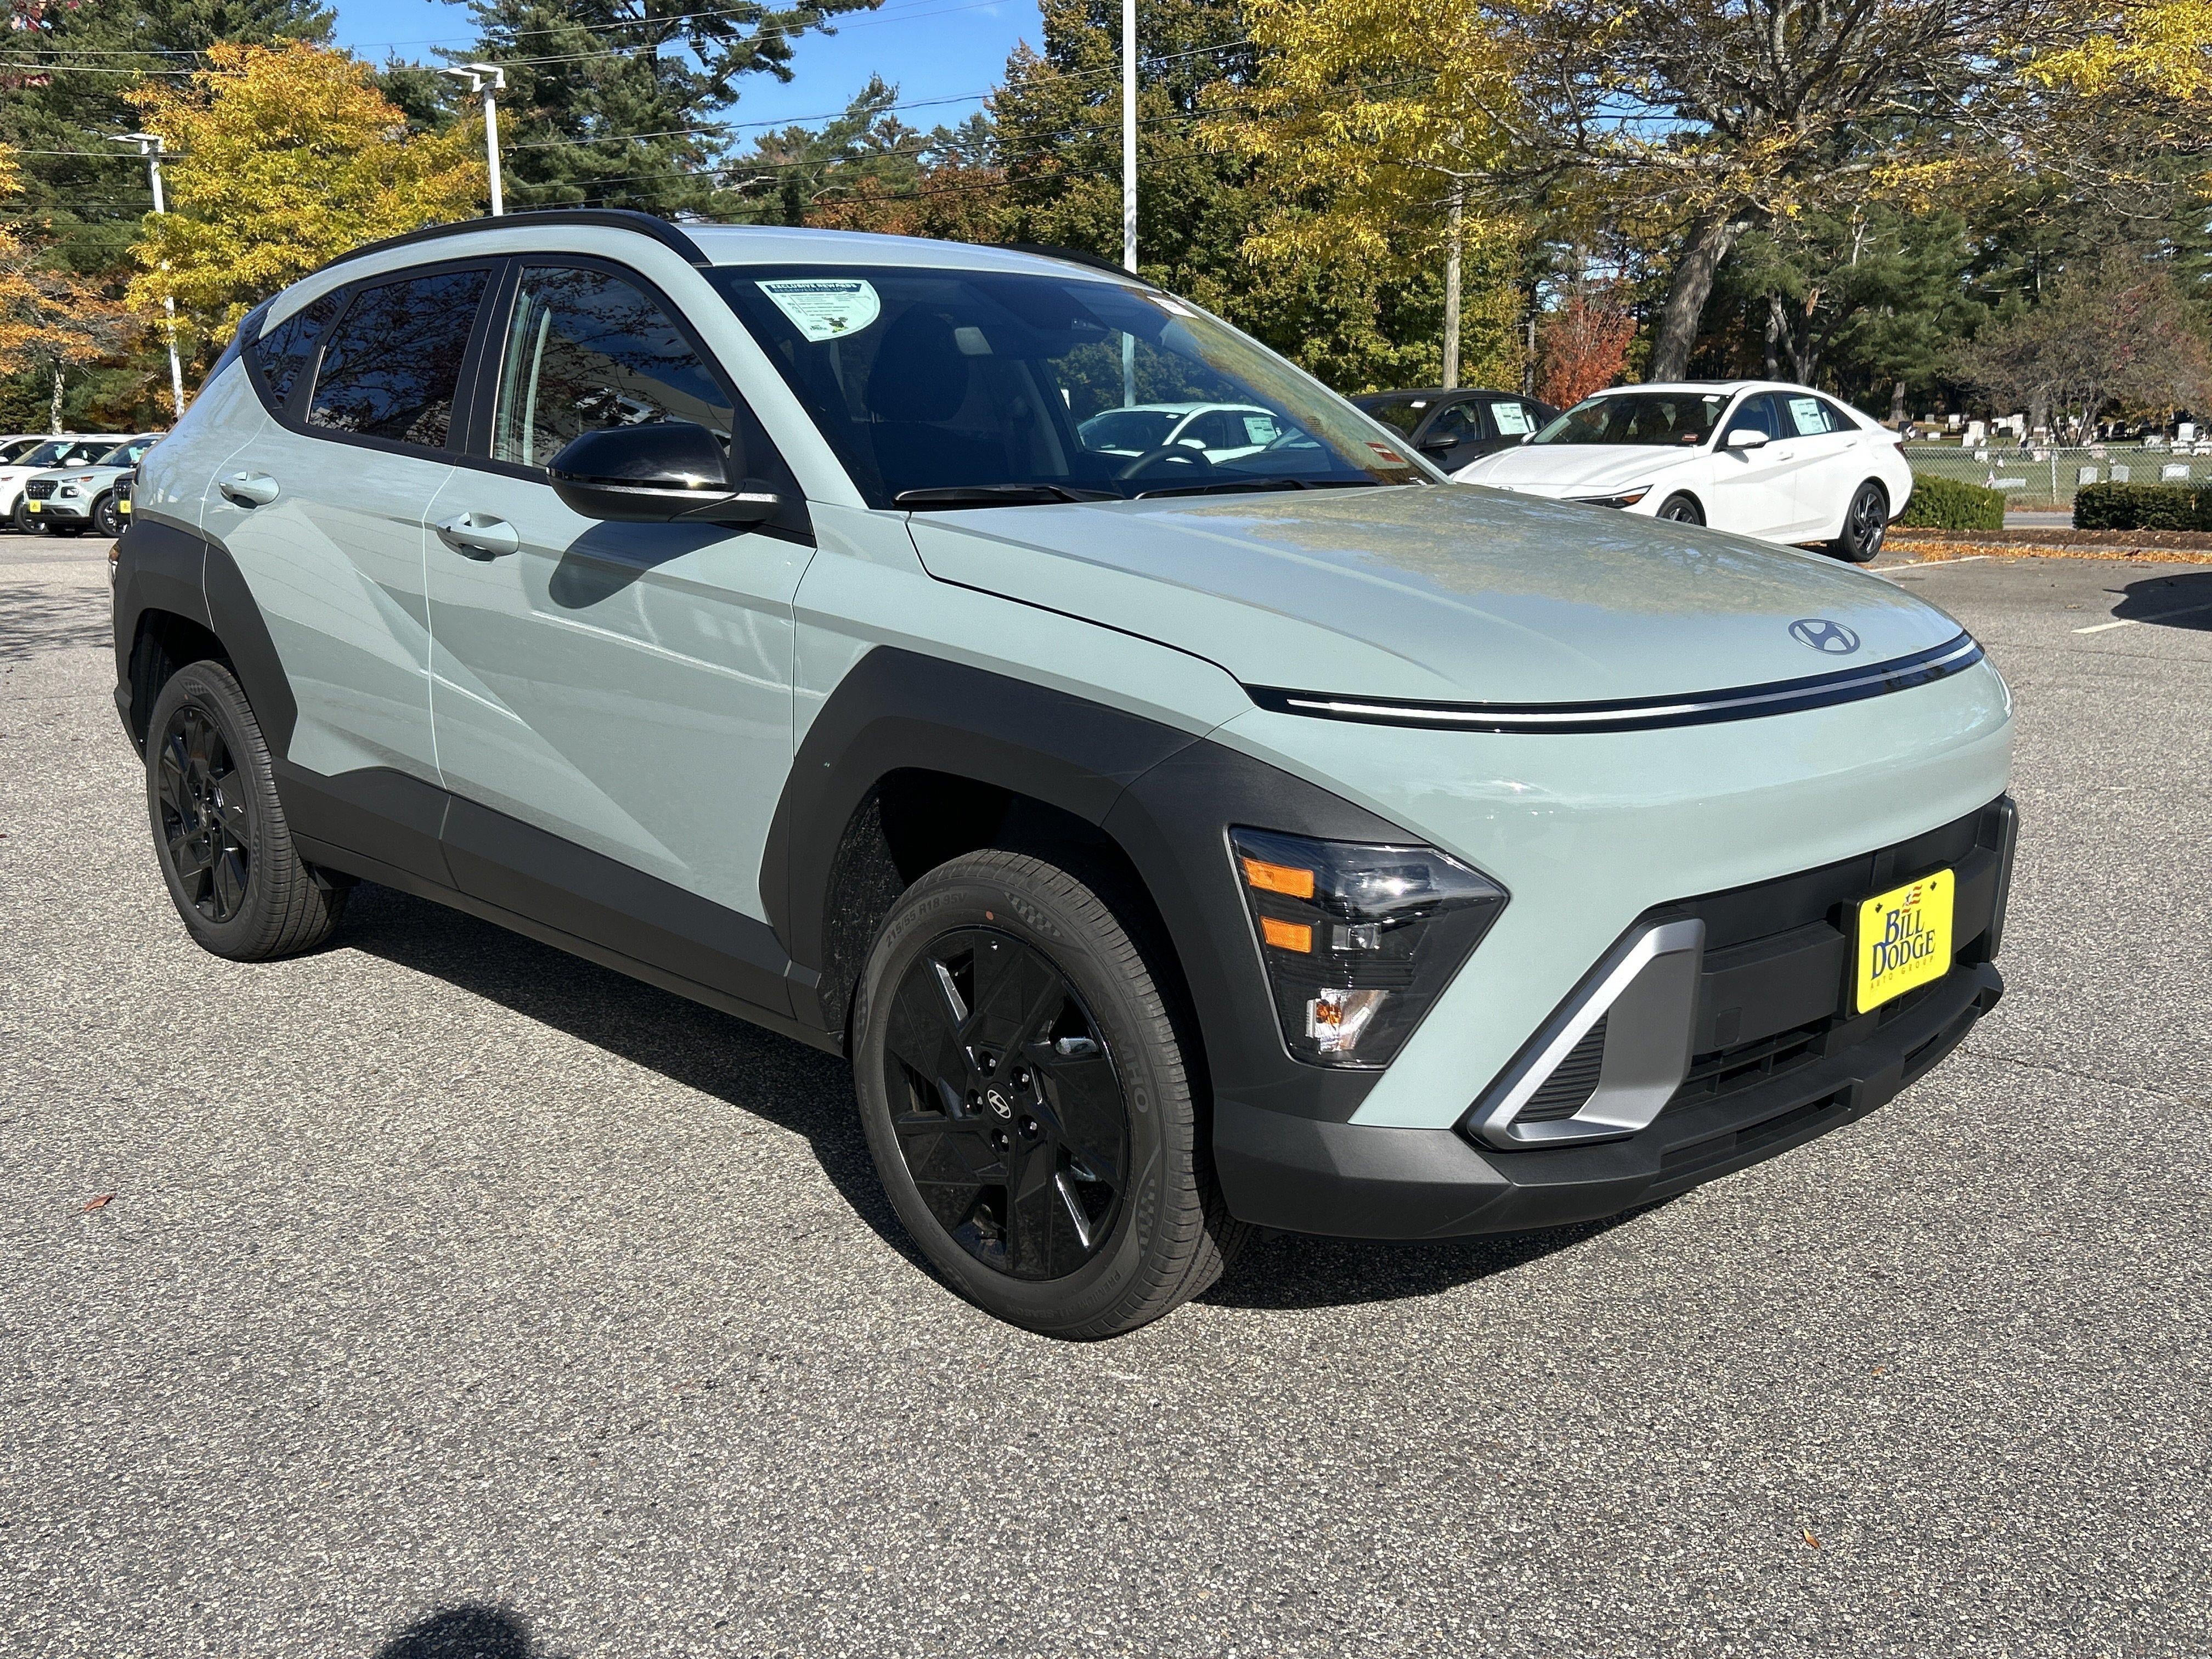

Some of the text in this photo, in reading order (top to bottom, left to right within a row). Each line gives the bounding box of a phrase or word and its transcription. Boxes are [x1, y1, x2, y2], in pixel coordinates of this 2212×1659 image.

[885, 909, 916, 949] 215/55
[918, 896, 940, 915] R18
[1884, 908, 1926, 946] BILL
[1870, 928, 1936, 981] DODGE
[1870, 955, 1934, 990] AUTO GROUP
